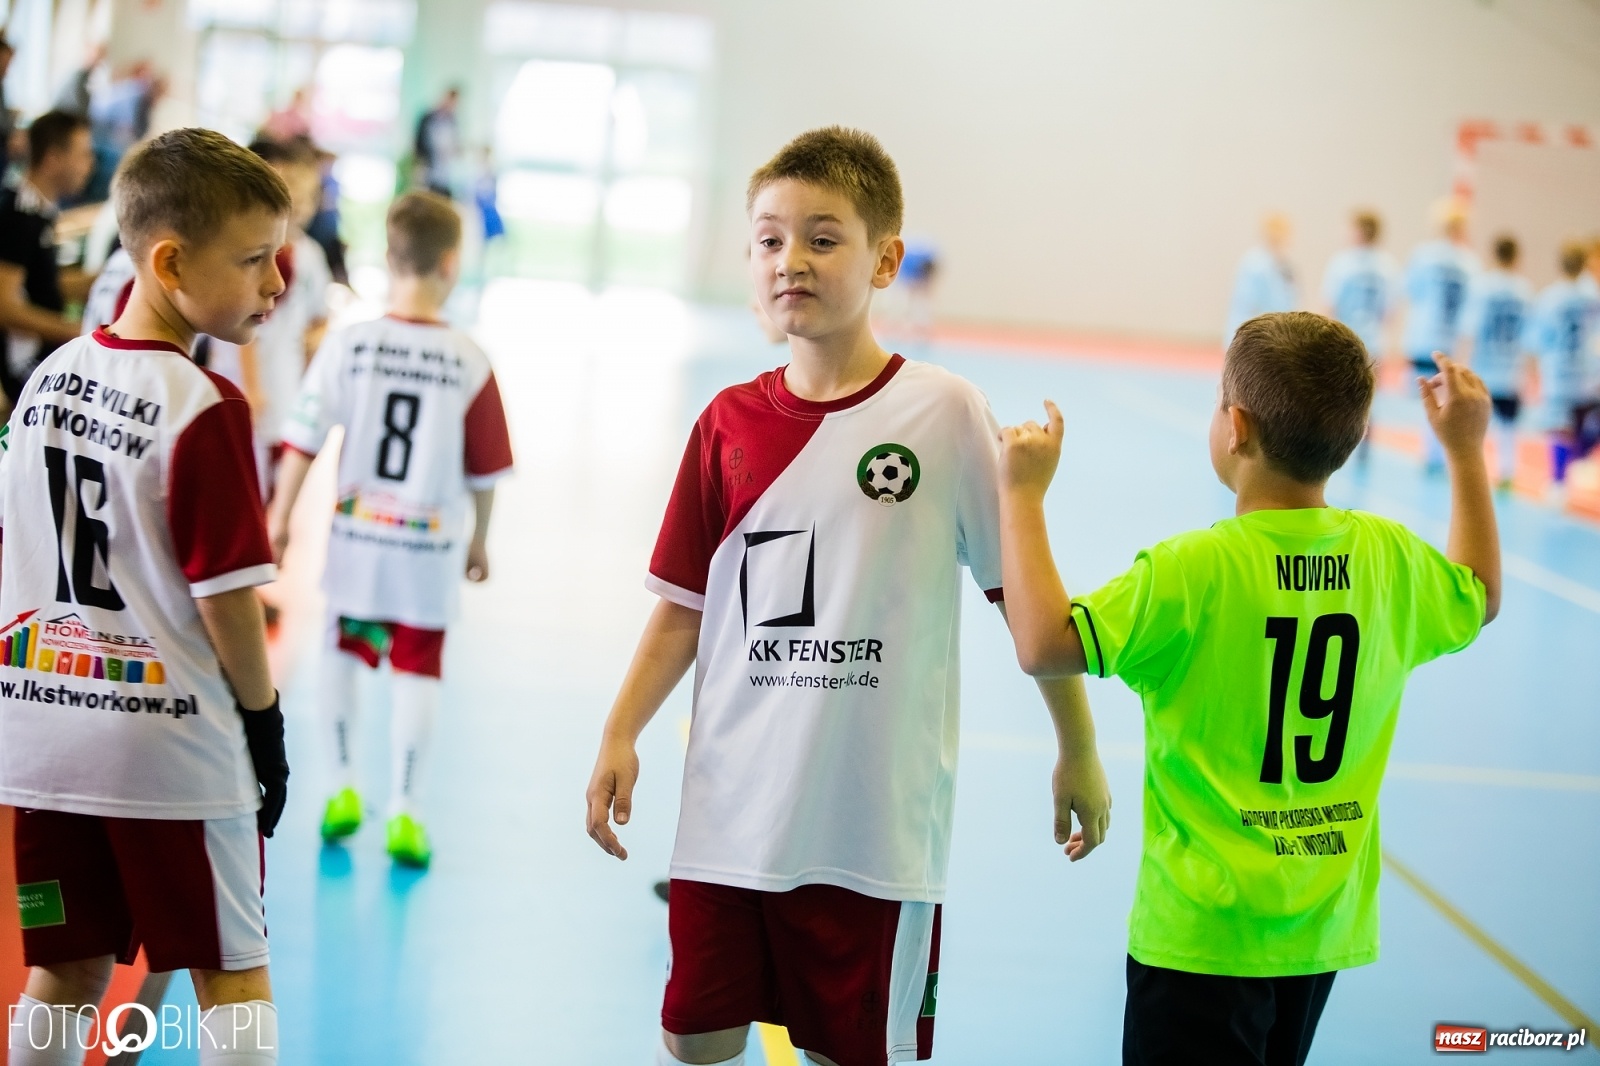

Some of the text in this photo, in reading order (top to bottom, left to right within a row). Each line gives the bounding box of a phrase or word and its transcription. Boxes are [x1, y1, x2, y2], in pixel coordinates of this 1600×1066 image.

[377, 391, 420, 481] 8
[44, 446, 126, 611] 16
[1276, 554, 1350, 591] NOWAK
[749, 639, 883, 663] KK FENSTER
[1259, 613, 1360, 784] 19
